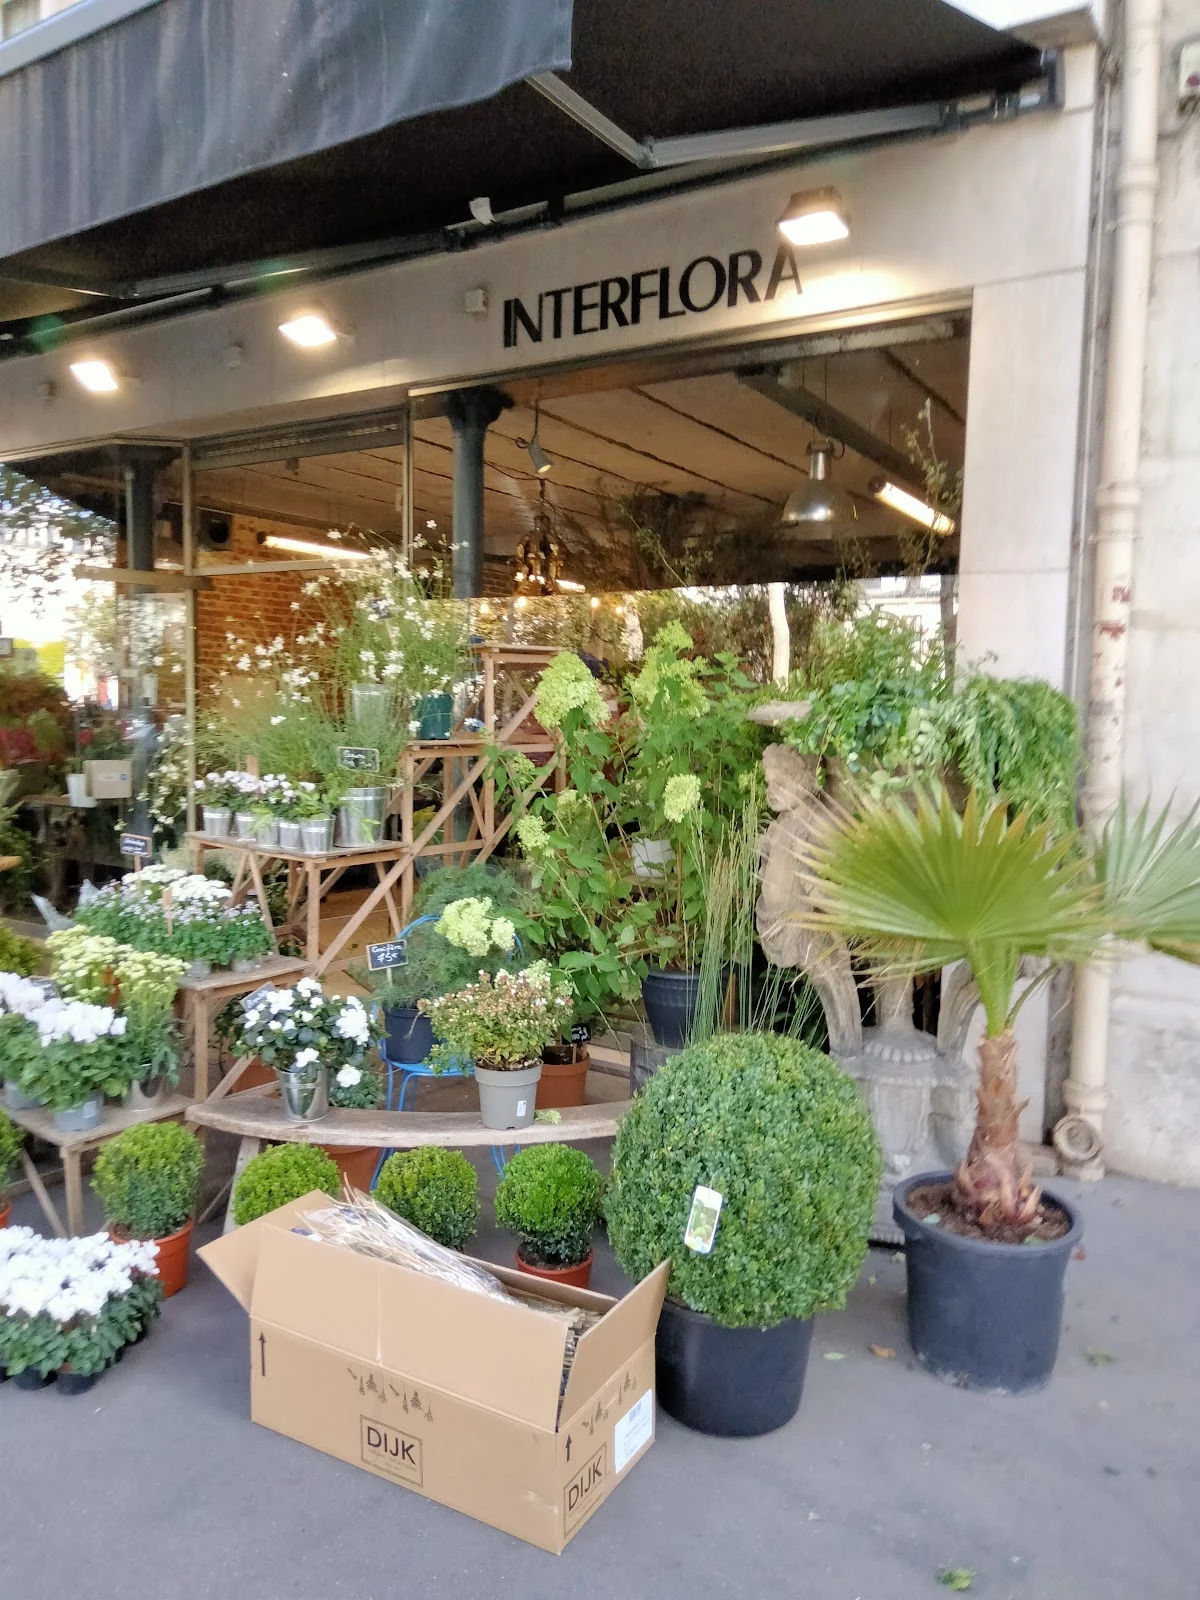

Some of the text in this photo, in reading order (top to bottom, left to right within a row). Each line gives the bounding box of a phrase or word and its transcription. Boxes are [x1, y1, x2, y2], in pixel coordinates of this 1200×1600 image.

[503, 242, 803, 348] INTERFLORA
[367, 1426, 417, 1466] DIJK
[568, 1456, 603, 1512] DIJK
